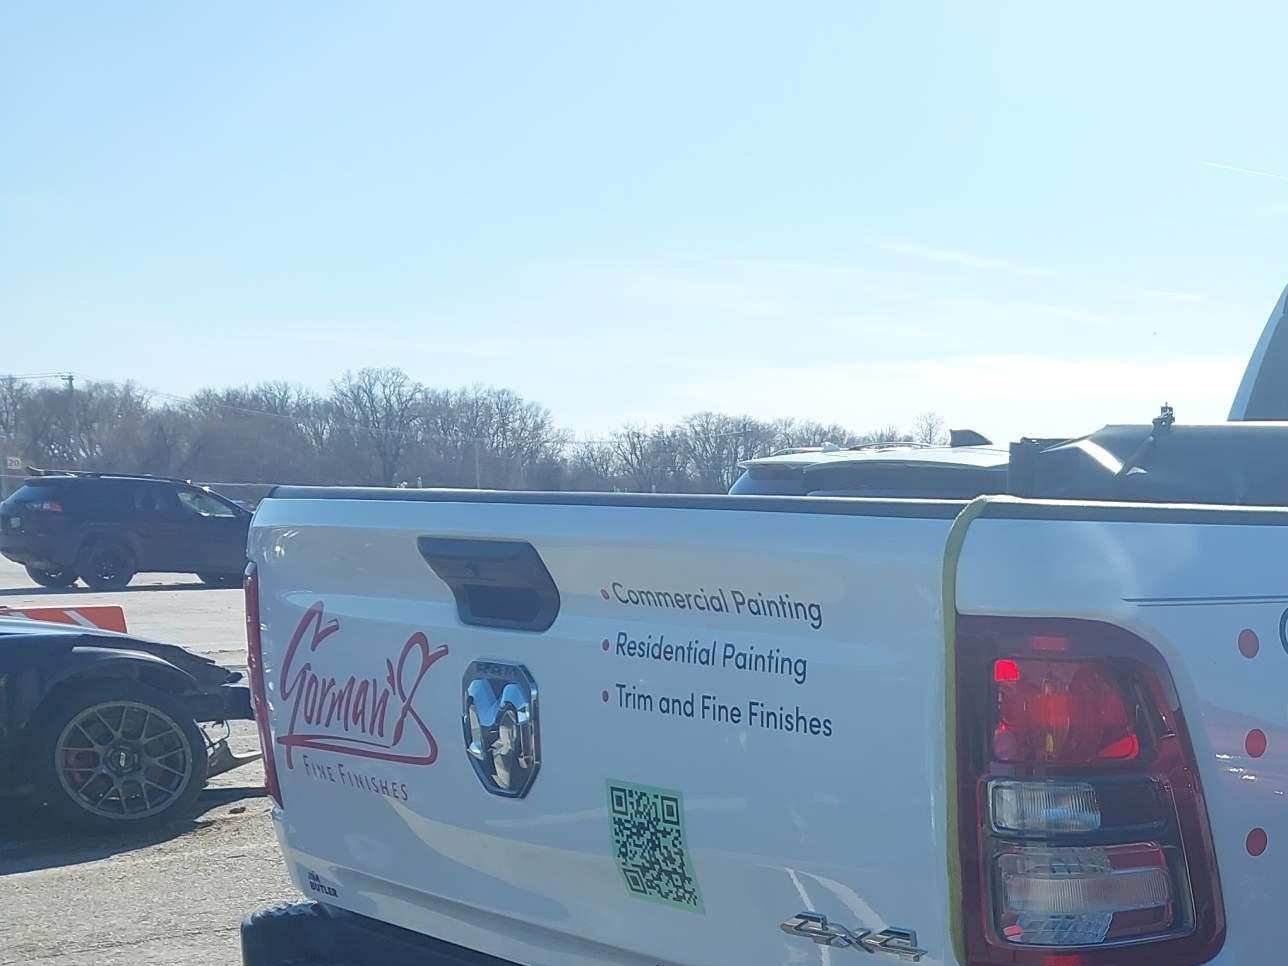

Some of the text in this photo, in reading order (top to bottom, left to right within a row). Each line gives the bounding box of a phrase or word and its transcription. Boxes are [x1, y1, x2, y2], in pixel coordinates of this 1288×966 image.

[612, 582, 822, 629] Commercial Painting
[616, 631, 807, 685] Residential Painting
[616, 683, 832, 736] Trim and Fine Finishes
[303, 755, 408, 801] FINE FINISHES
